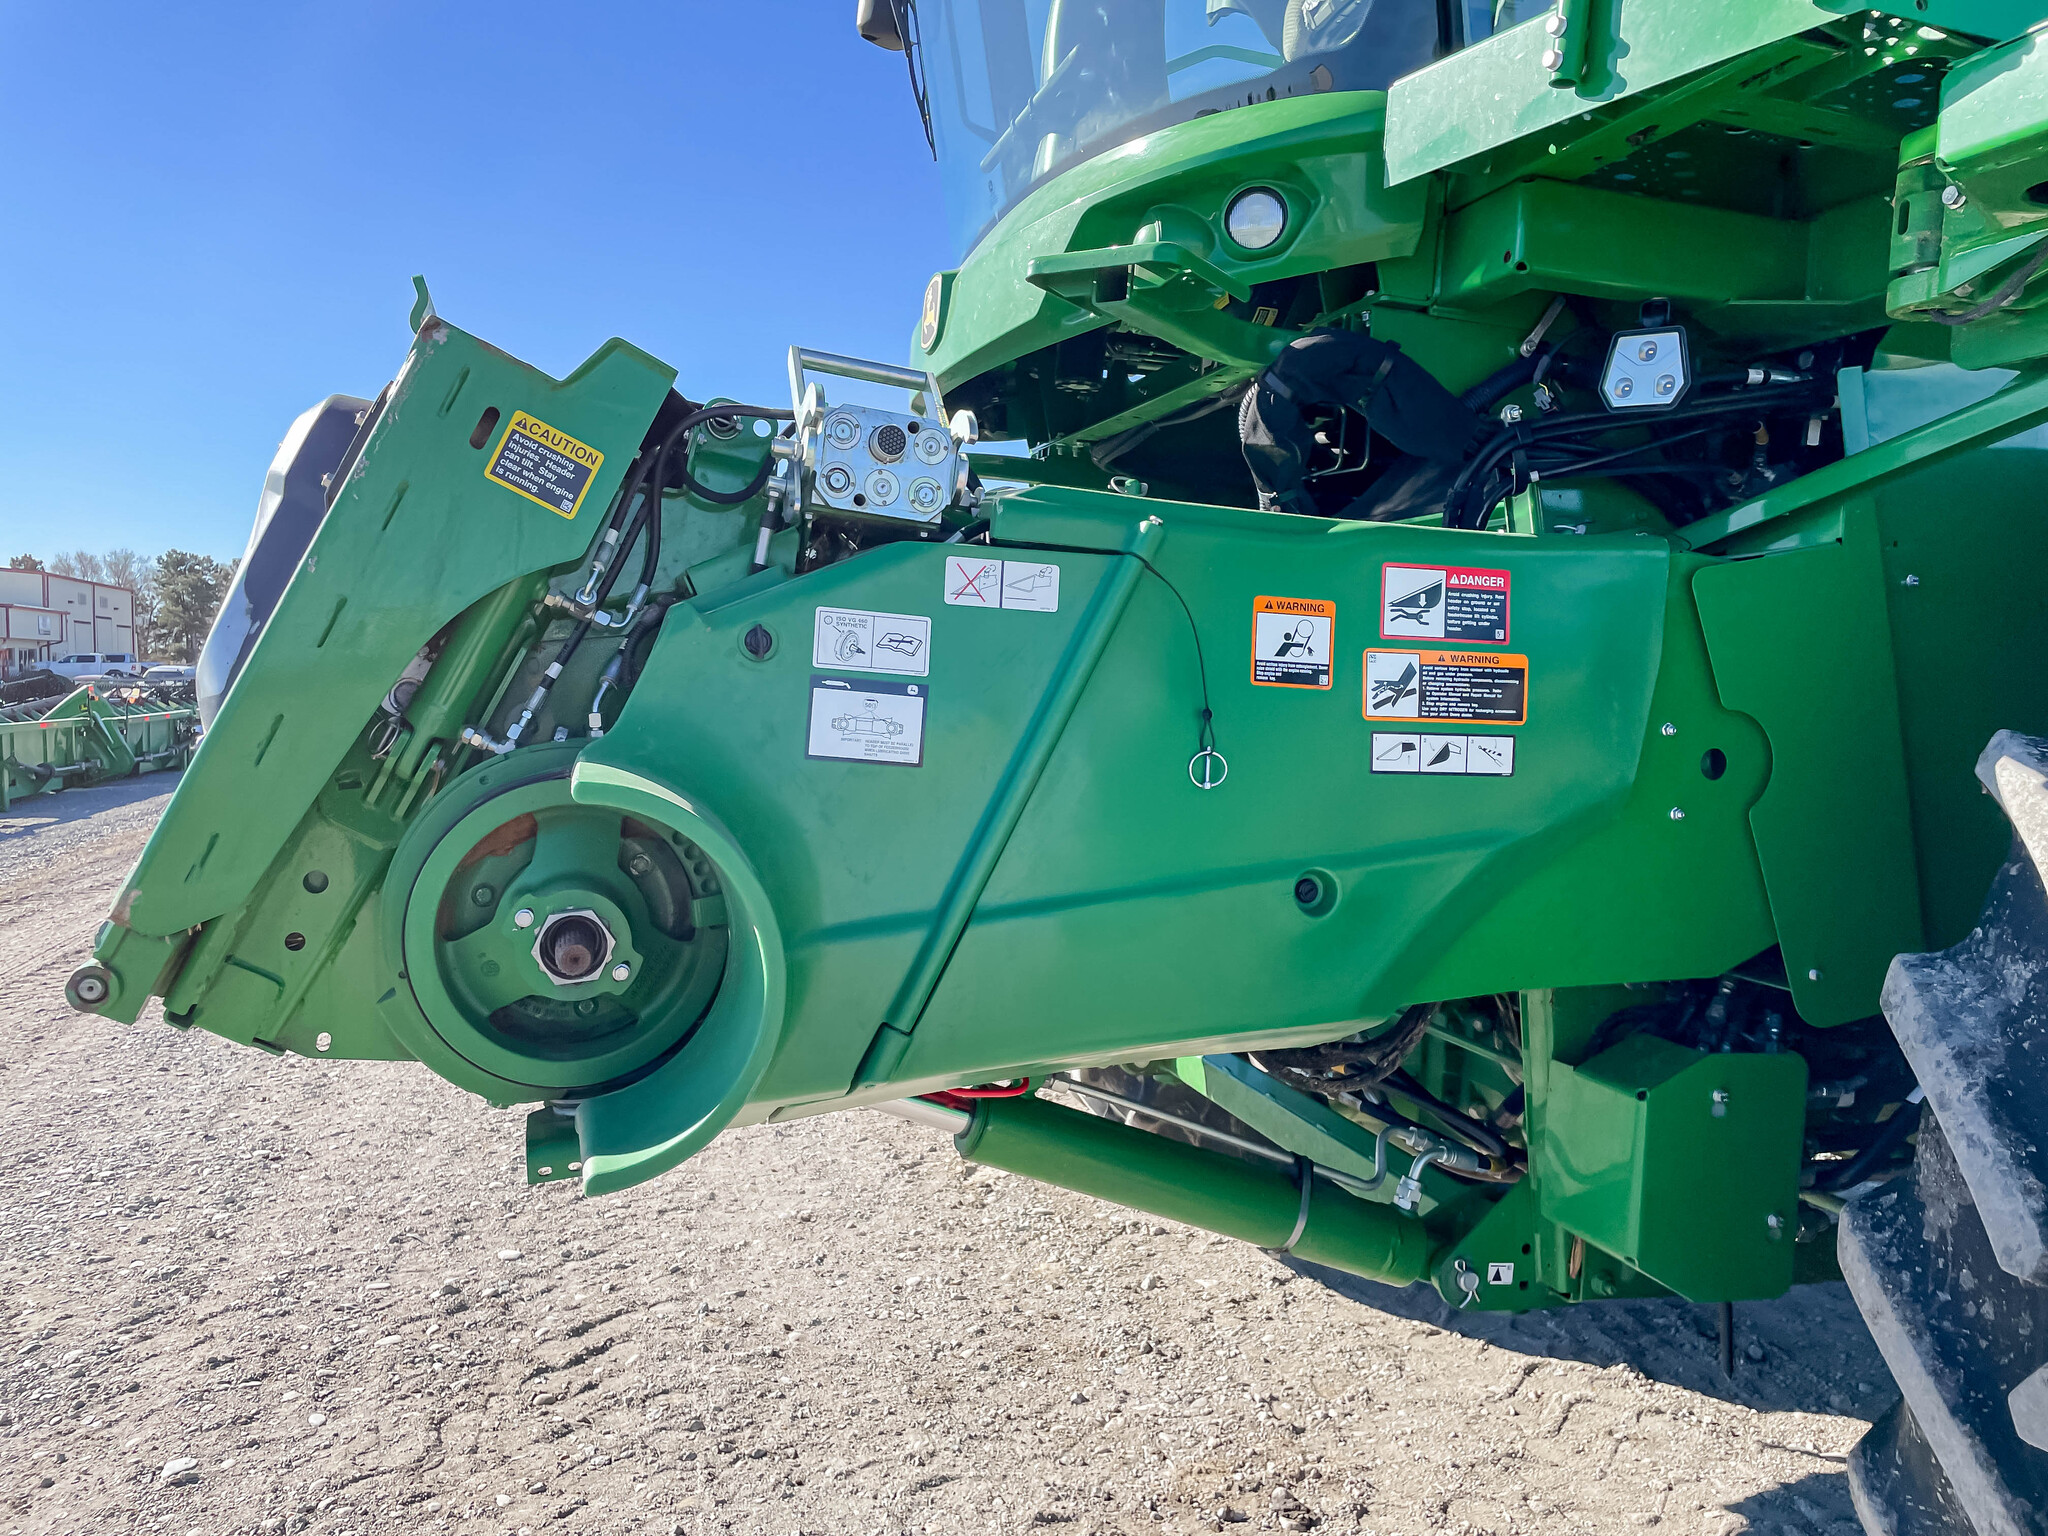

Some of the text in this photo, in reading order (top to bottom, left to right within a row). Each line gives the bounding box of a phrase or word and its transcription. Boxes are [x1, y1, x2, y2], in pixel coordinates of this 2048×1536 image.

[512, 433, 575, 470] Avoid crushing
[529, 423, 598, 465] CAUTION
[496, 466, 539, 493] is running.
[500, 459, 573, 500] clear when engine
[504, 451, 557, 481] can tilt. Stay
[546, 460, 575, 480] Header
[1460, 575, 1504, 587] DANGER
[1277, 601, 1325, 612] WARNING
[1451, 655, 1500, 664] WARNING
